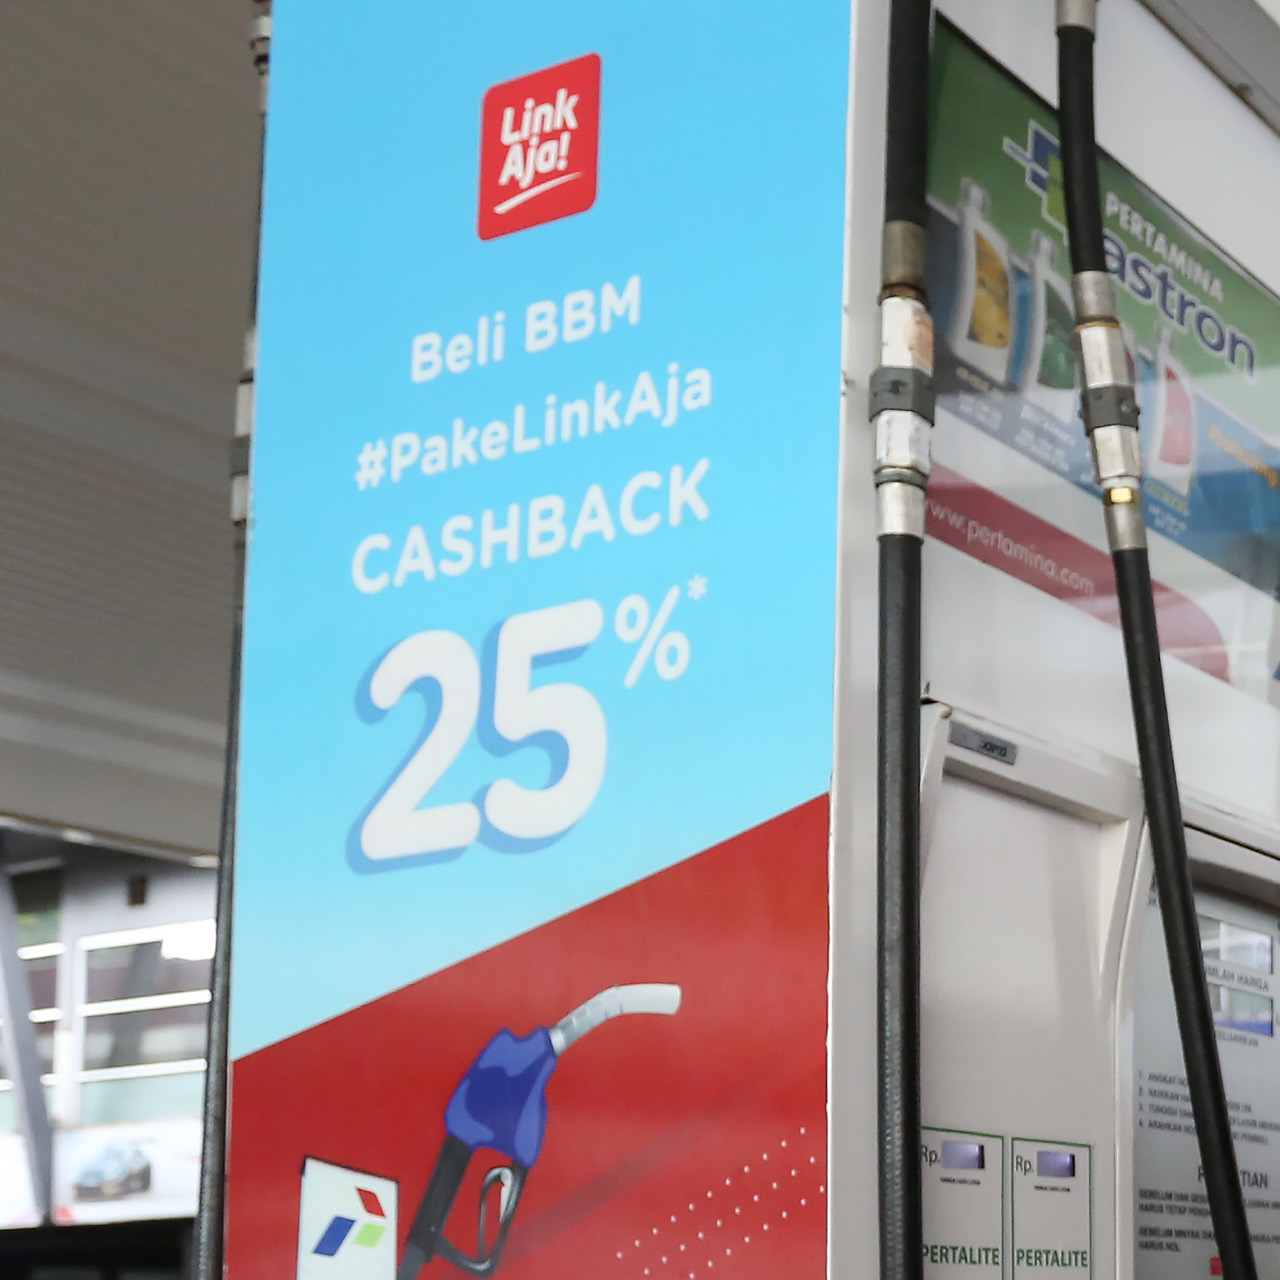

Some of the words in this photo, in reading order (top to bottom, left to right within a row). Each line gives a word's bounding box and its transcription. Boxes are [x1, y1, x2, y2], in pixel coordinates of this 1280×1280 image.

[501, 88, 579, 146] Link
[498, 131, 572, 190] Aja!
[1105, 191, 1224, 302] PERTAMINA
[410, 310, 504, 383] Beli
[524, 274, 642, 354] BBM
[1102, 227, 1258, 382] astron
[354, 361, 713, 490] #PakeLinkAja
[350, 457, 711, 595] CASHBACK
[1016, 1155, 1034, 1176] Rp.
[1198, 1165, 1268, 1188] PTIAN
[922, 1244, 1000, 1266] PERTALITE
[1016, 1249, 1089, 1268] PERTALITE
